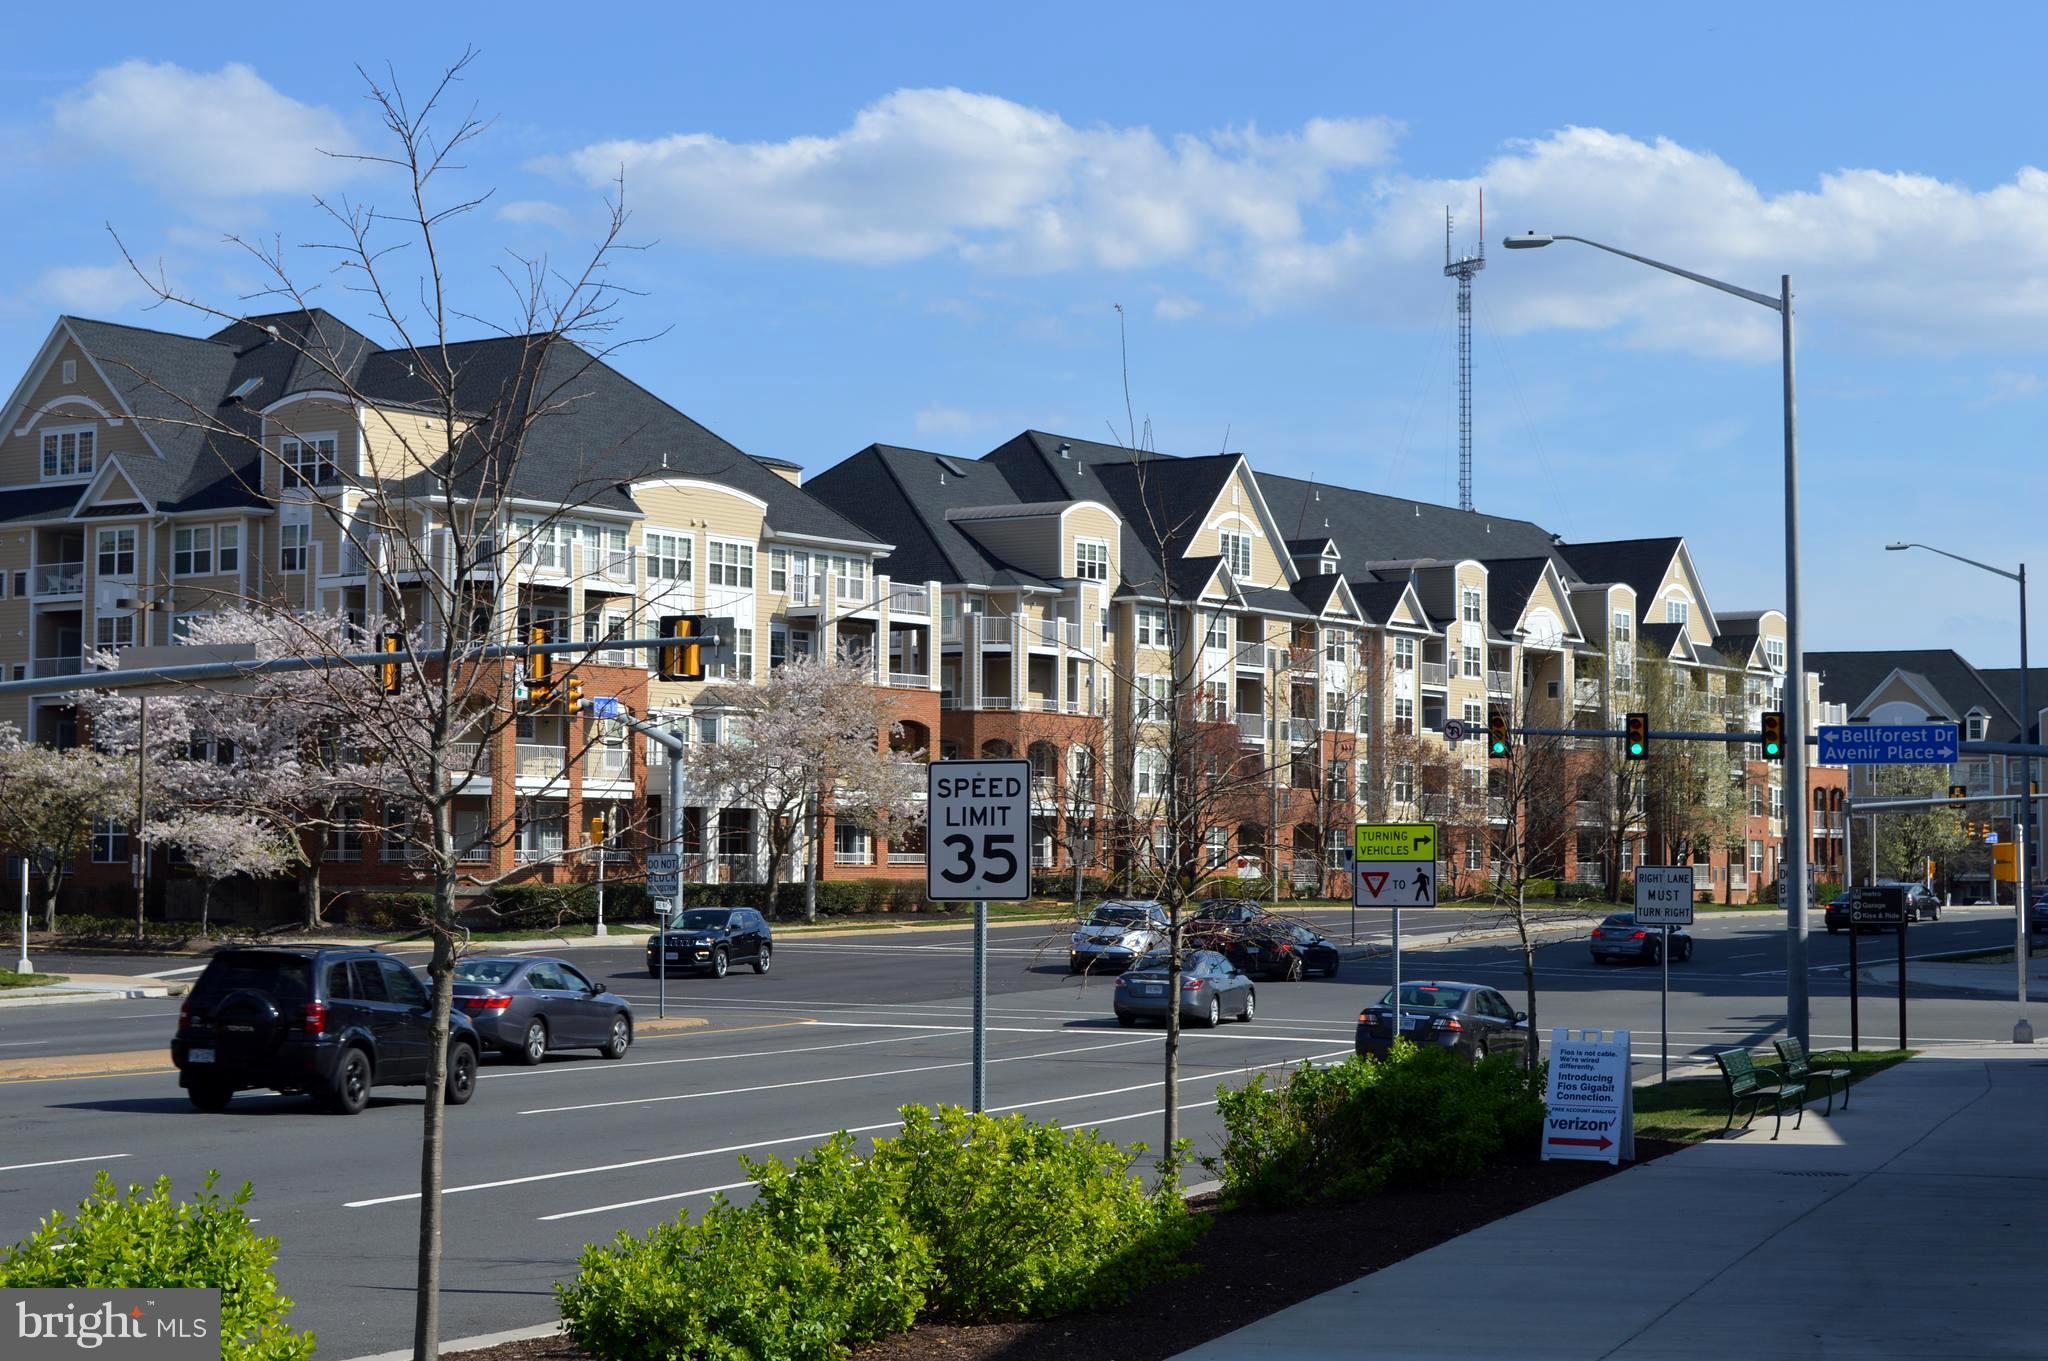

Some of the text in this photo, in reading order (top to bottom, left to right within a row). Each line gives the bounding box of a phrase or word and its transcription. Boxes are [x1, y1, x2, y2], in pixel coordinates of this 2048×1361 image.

[1842, 729, 1954, 743] Bellforest Dr
[1825, 745, 1935, 760] Avenir Place
[937, 777, 1021, 798] SPEED
[946, 806, 1011, 826] LIMIT
[1362, 831, 1408, 841] TURNING
[1360, 845, 1410, 856] VEHICLES
[649, 859, 676, 869] DO NOT
[941, 834, 1018, 884] 35
[1639, 873, 1690, 884] RIGHT LANE
[1393, 880, 1406, 890] TO
[1648, 889, 1680, 902] MUST
[1638, 907, 1690, 918] TURN RIGHT
[1559, 1063, 1595, 1071] differently.
[1558, 1072, 1613, 1084] Introducing
[1557, 1082, 1615, 1093] Fios Gigabit
[1556, 1092, 1613, 1102] Connection.
[1549, 1117, 1608, 1131] verizon
